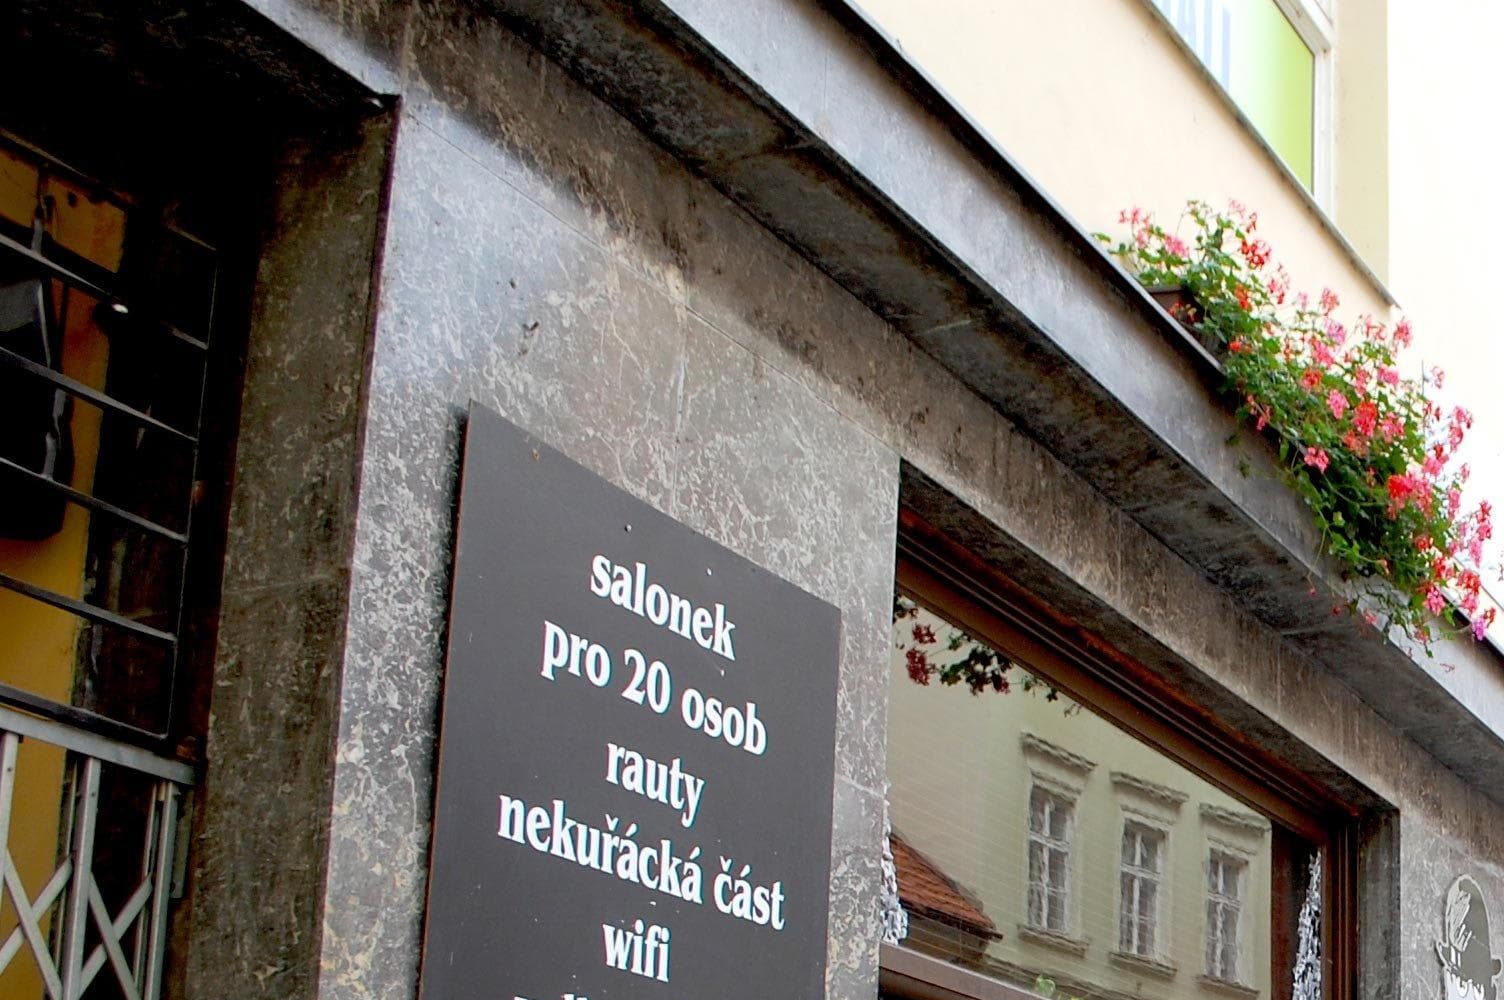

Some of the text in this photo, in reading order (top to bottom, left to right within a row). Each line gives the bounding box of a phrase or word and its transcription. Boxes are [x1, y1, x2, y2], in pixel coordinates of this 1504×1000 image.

[590, 553, 736, 661] salonek
[540, 620, 767, 755] pro 20 osob
[605, 742, 705, 828] rauty
[497, 794, 785, 930] nekuřácká část
[602, 919, 670, 983] wifi
